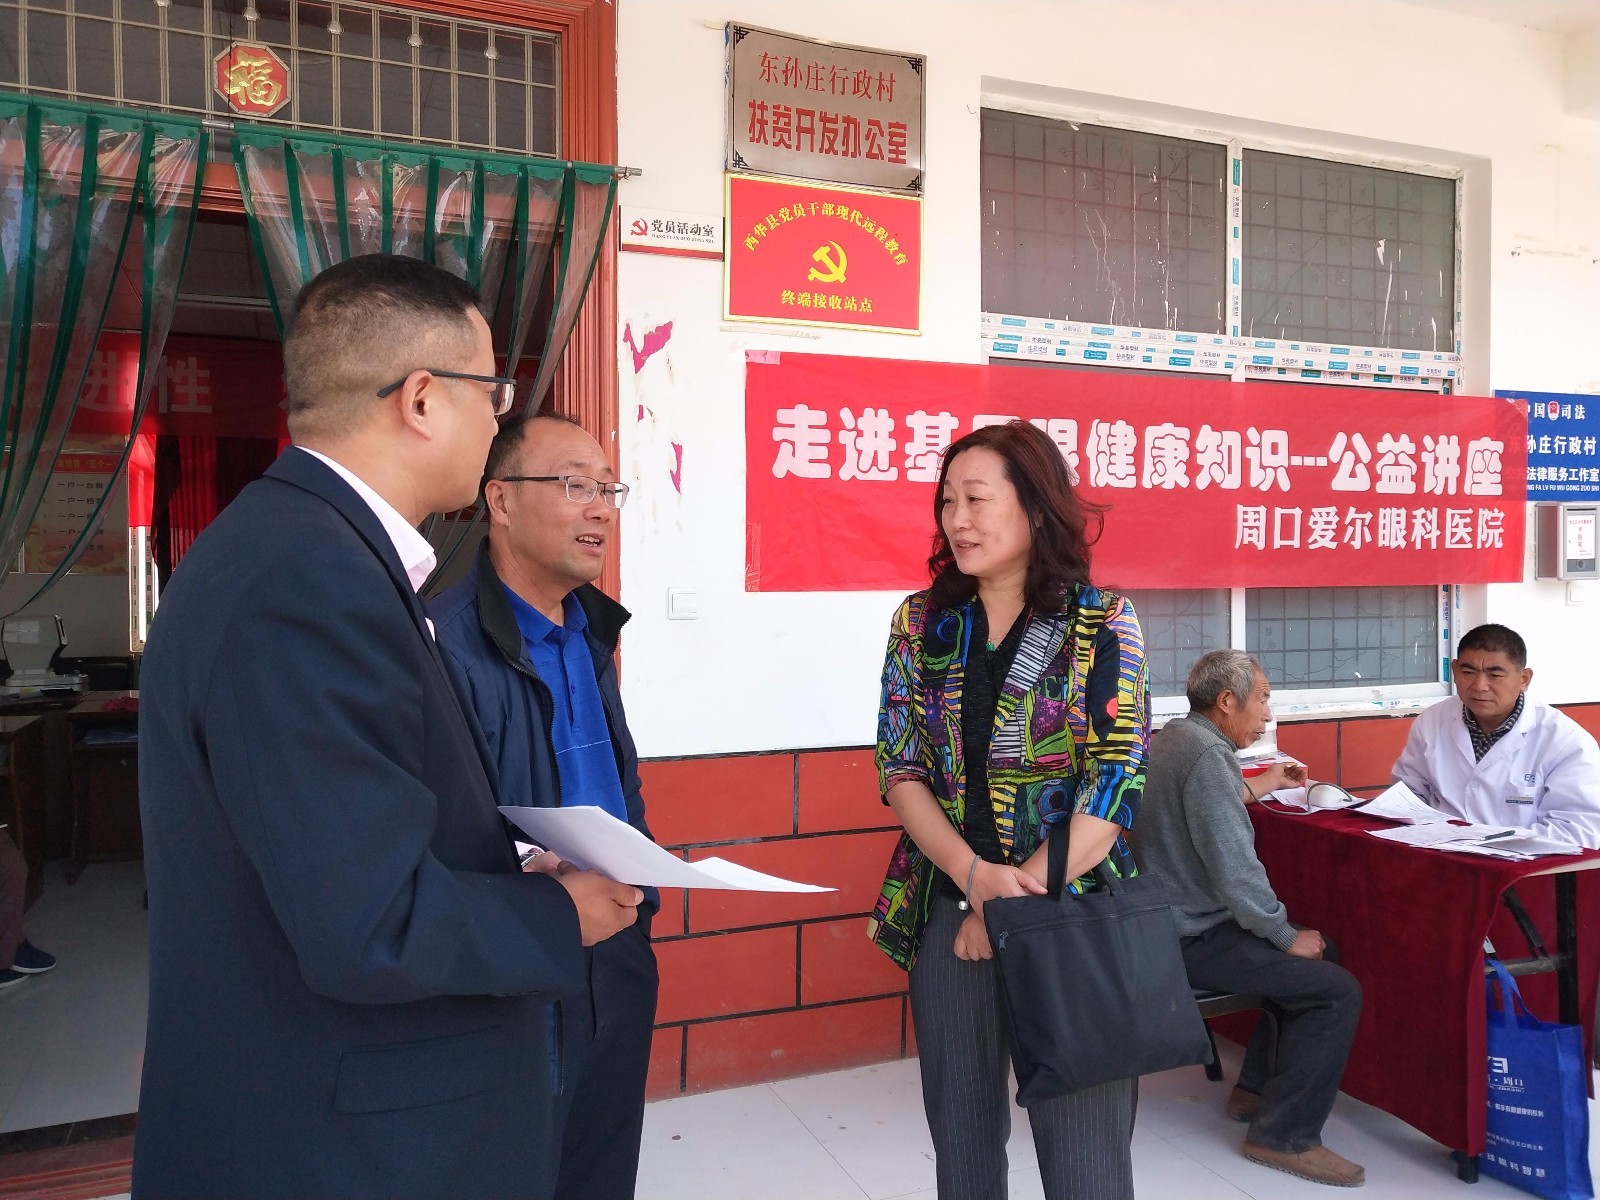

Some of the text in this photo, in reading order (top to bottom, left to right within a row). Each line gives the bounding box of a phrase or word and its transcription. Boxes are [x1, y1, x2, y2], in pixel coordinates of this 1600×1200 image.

[224, 50, 282, 106] 福
[758, 51, 896, 102] 东孙庄行政村
[748, 99, 907, 164] 扶贫开发办公室
[651, 218, 715, 238] 党员活动室
[743, 202, 909, 266] 西华县党员干部现代远程教育
[781, 289, 873, 313] 终端接收站点
[1560, 404, 1586, 420] 司法
[1235, 503, 1505, 550] 周口爱尔眼科医院
